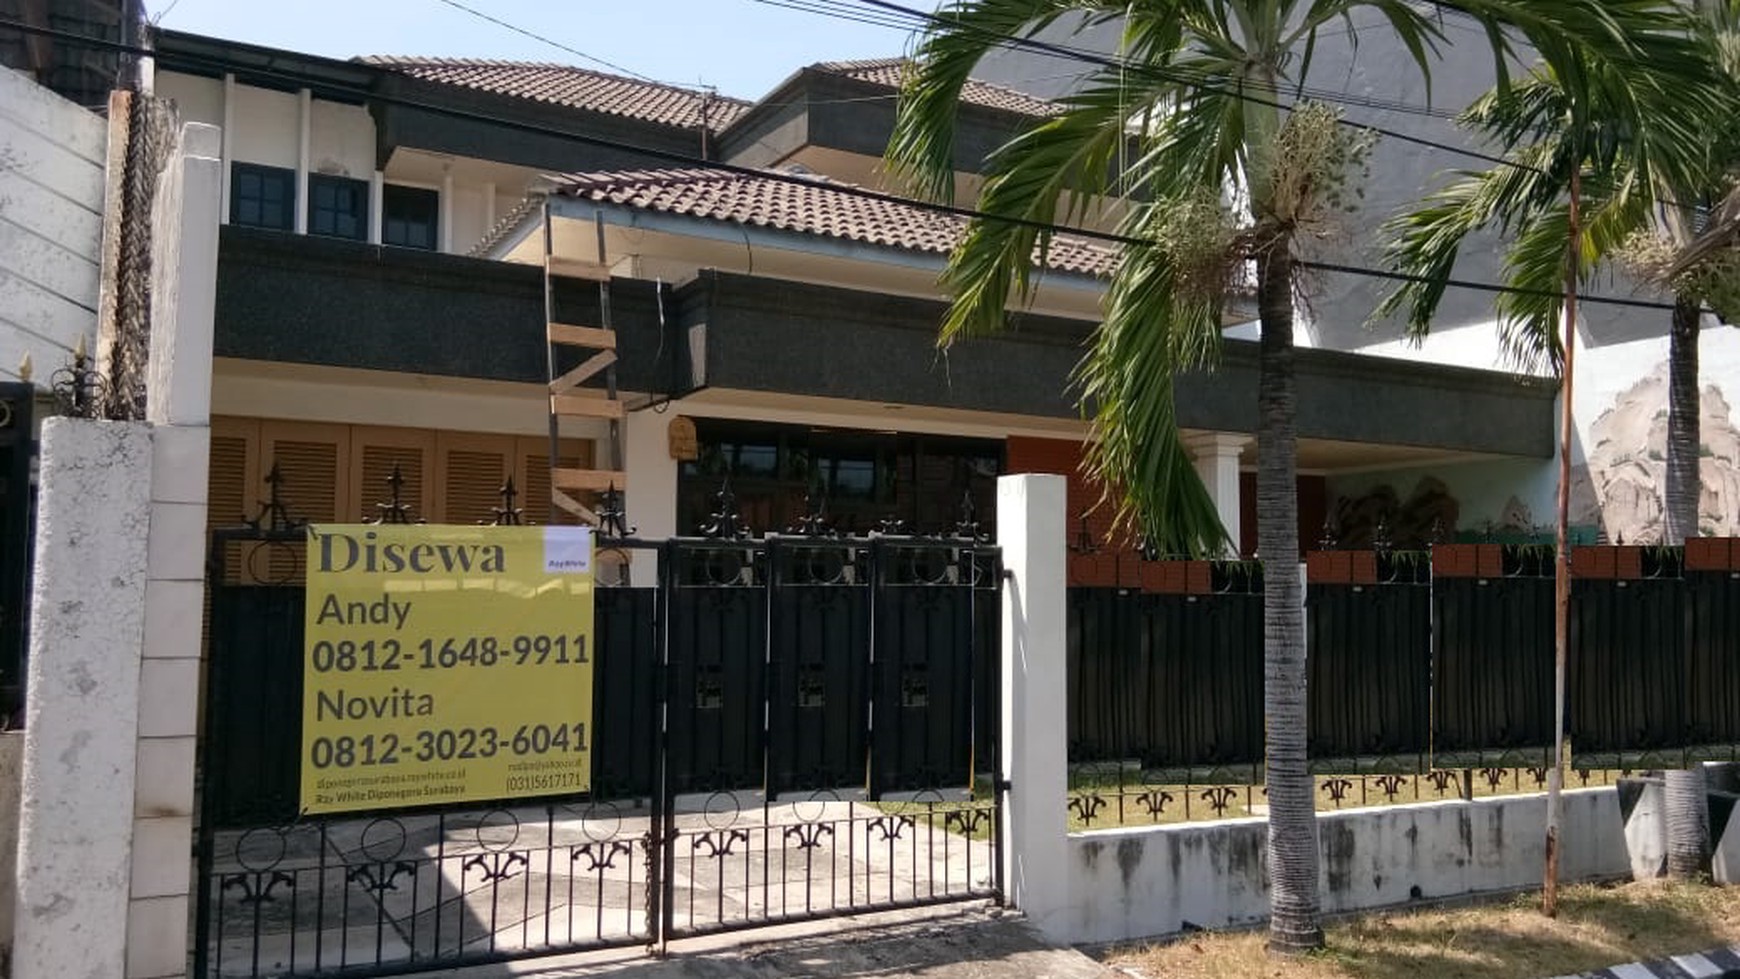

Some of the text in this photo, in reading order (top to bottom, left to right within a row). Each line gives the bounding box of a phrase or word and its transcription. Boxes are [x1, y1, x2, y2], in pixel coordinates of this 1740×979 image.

[317, 532, 505, 573] Disewa
[316, 593, 412, 629] Andy
[312, 634, 589, 673] 0812-1648-9911
[317, 687, 435, 722] Novita
[311, 722, 588, 769] 0812-3023-6041
[336, 790, 366, 802] White
[506, 772, 581, 793] (031)5617171
